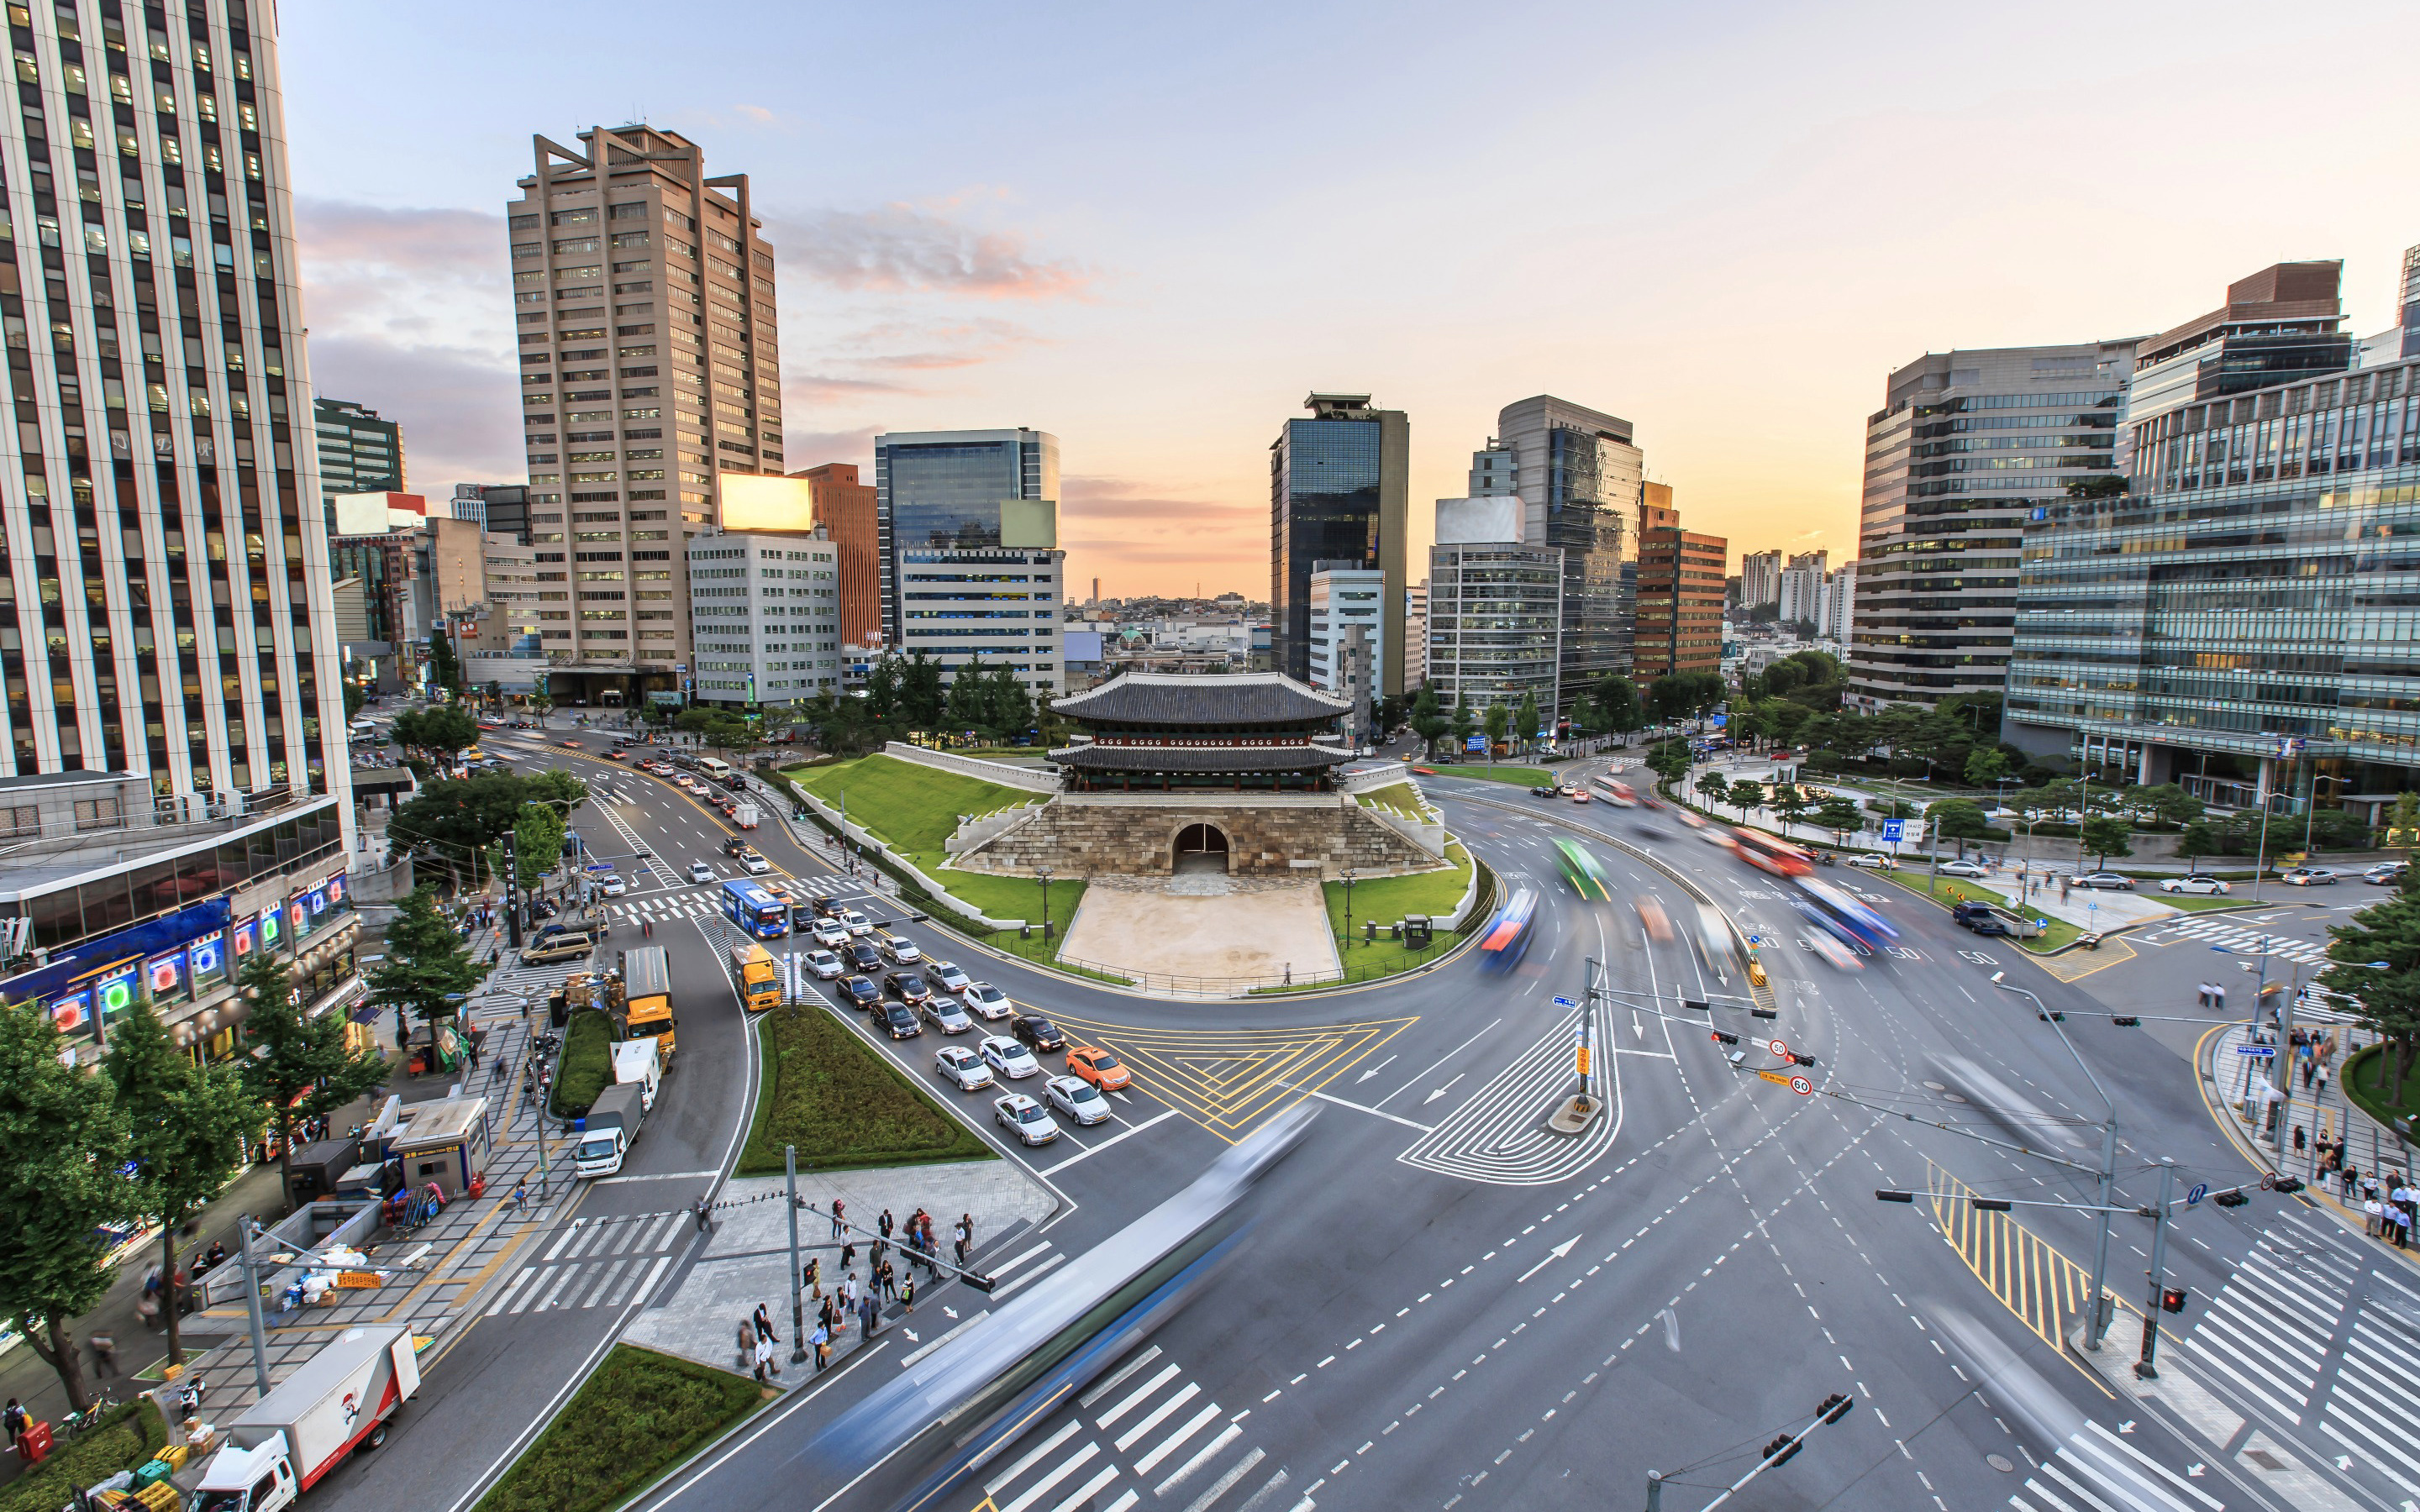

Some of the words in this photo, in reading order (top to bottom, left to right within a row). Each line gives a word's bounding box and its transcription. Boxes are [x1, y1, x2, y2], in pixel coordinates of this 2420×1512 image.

[506, 863, 517, 911] 남대문시장
[1884, 946, 1921, 959] 50
[1956, 950, 1999, 965] 50
[1774, 1044, 1784, 1053] 50
[1794, 1080, 1808, 1091] 60
